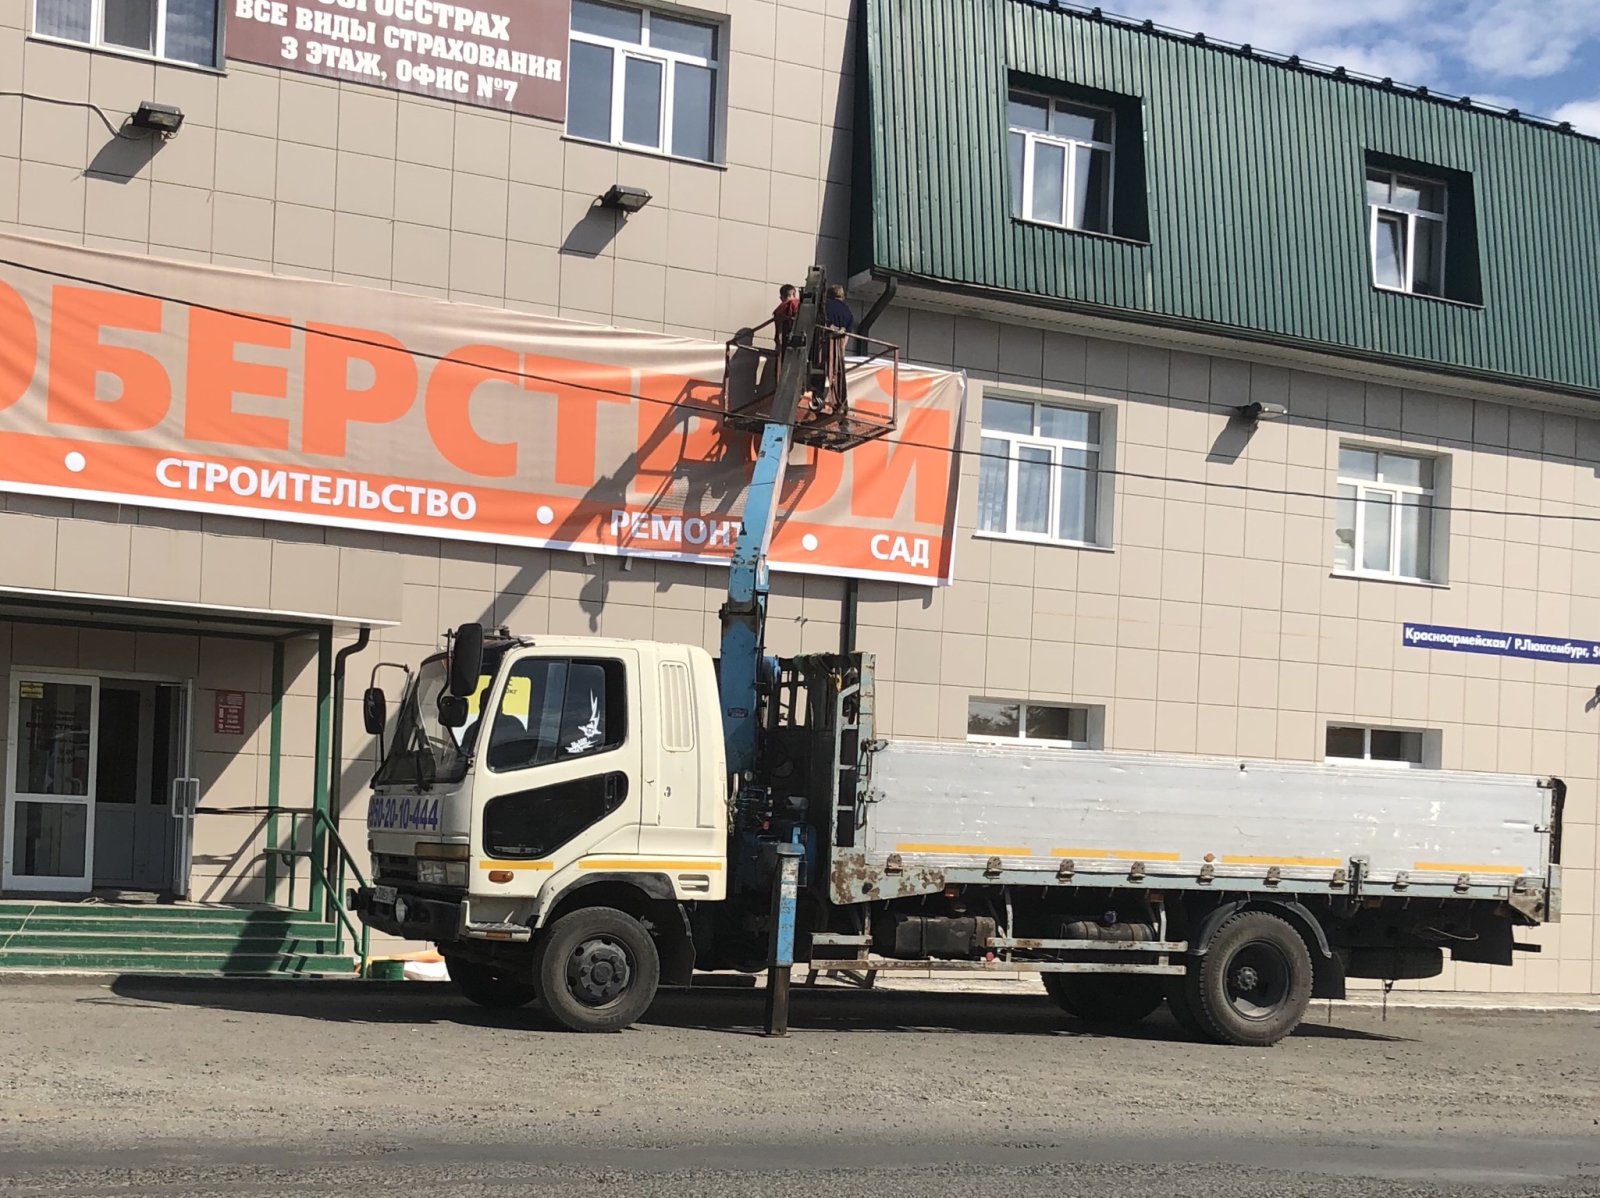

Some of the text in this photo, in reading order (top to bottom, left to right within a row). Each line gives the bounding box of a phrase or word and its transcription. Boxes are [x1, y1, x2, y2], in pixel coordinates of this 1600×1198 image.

[235, 0, 562, 82] ВСЕ ВИДЫ СТРАХОВАНИЯ
[318, 0, 511, 41] ОССТРАХ
[281, 36, 299, 59] 3
[305, 41, 388, 81] ЭТАЖ,
[395, 59, 470, 93] ОФИС
[0, 278, 950, 526] БЕРСТРЙ
[155, 457, 477, 521] СТРОИТЕЛЬСТВО
[870, 534, 929, 569] САД
[1405, 627, 1512, 650] Красноармейская/
[1592, 645, 1600, 658] 5
